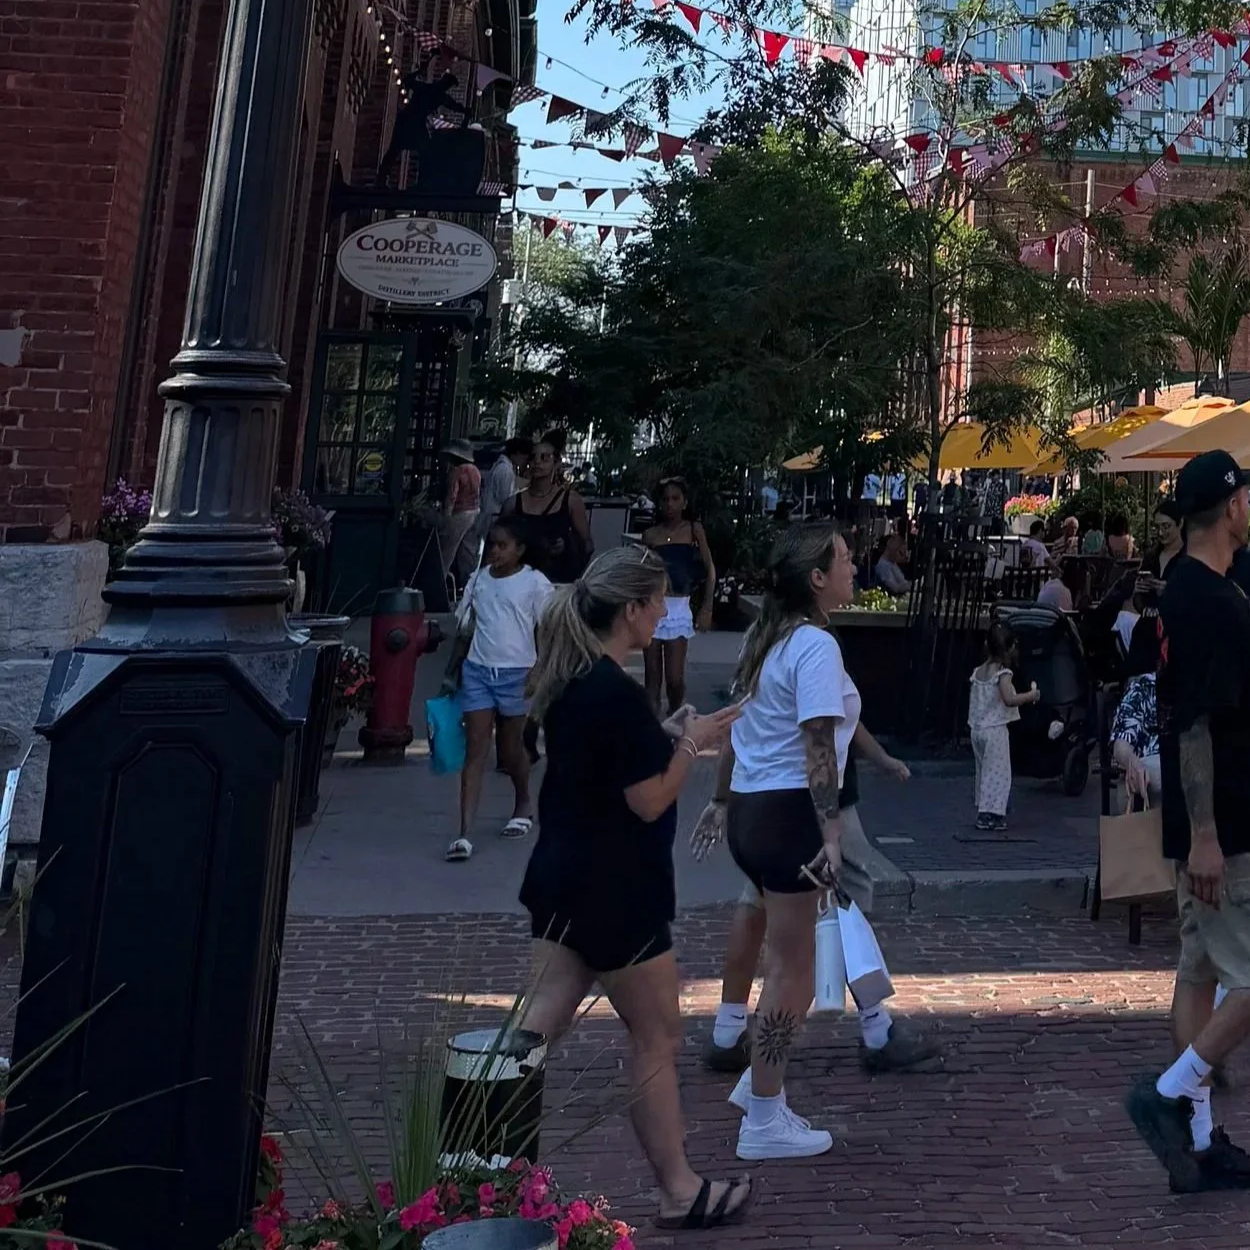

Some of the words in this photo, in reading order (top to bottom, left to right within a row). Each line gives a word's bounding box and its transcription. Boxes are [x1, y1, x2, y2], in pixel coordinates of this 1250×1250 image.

[356, 234, 483, 258] COOPERAGE
[375, 254, 460, 268] MARKETPLACE
[377, 284, 416, 297] DISTILLERY
[417, 287, 450, 297] DISTRICT
